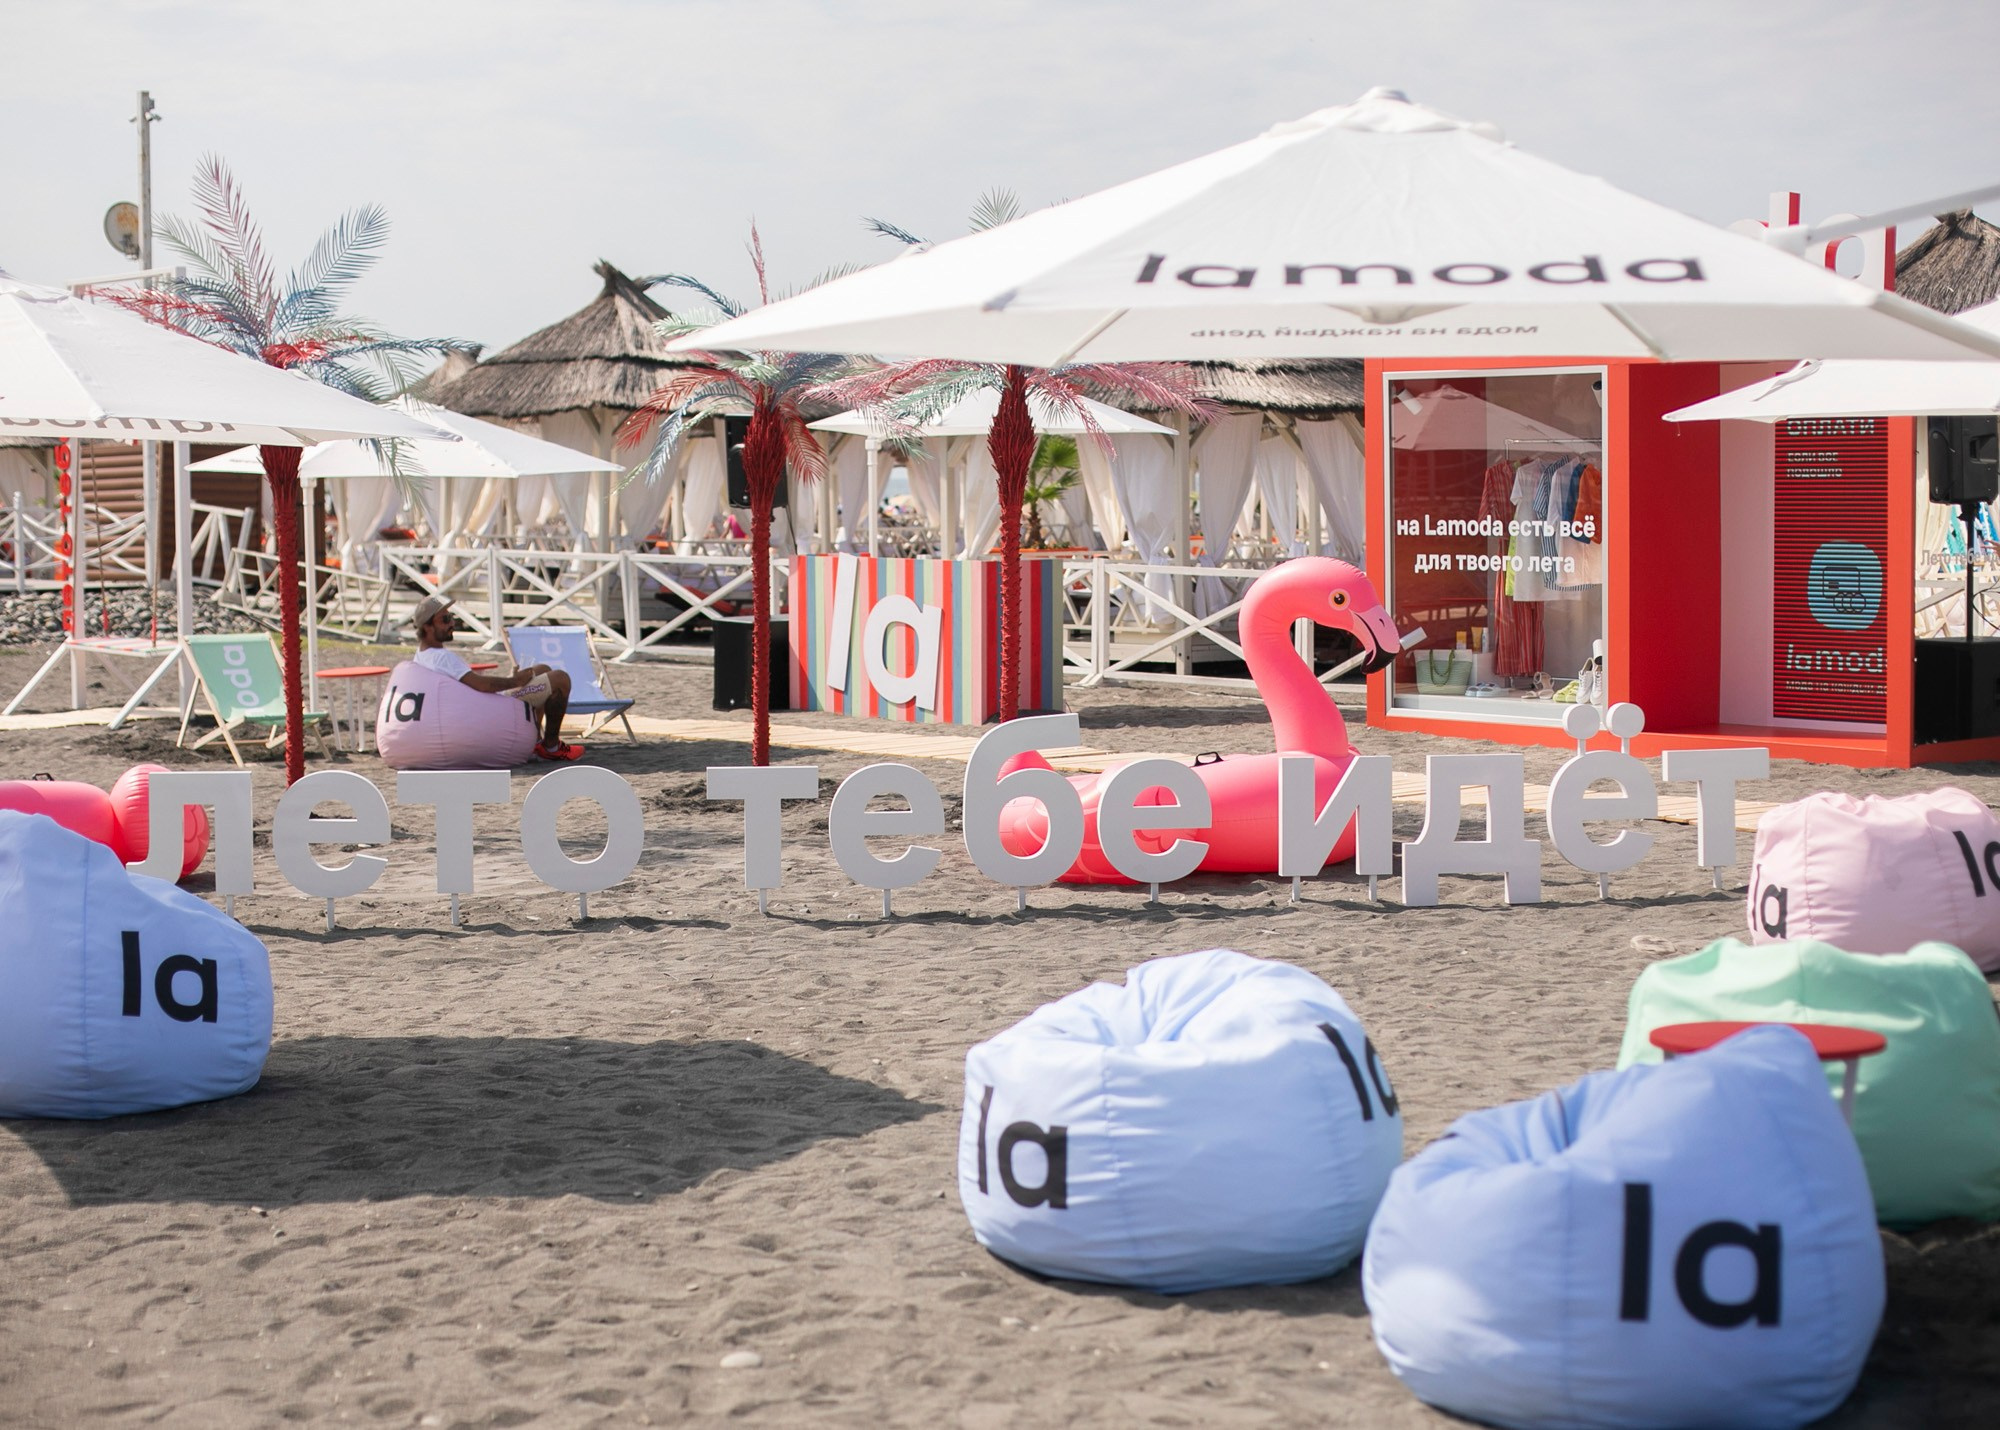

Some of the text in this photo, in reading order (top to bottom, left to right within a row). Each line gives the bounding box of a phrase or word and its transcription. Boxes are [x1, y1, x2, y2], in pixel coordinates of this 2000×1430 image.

[1134, 253, 1708, 289] lamoda
[1396, 514, 1596, 538] на Lamoda есть всё
[1414, 553, 1575, 574] для твоего лета
[827, 552, 942, 712] la
[1786, 643, 1887, 673] lamod
[385, 686, 425, 723] la
[126, 702, 1770, 907] лето тебе идёт
[1752, 863, 1788, 939] la
[121, 930, 219, 1024] la
[977, 1085, 1068, 1210] la
[1619, 1182, 1783, 1329] la
